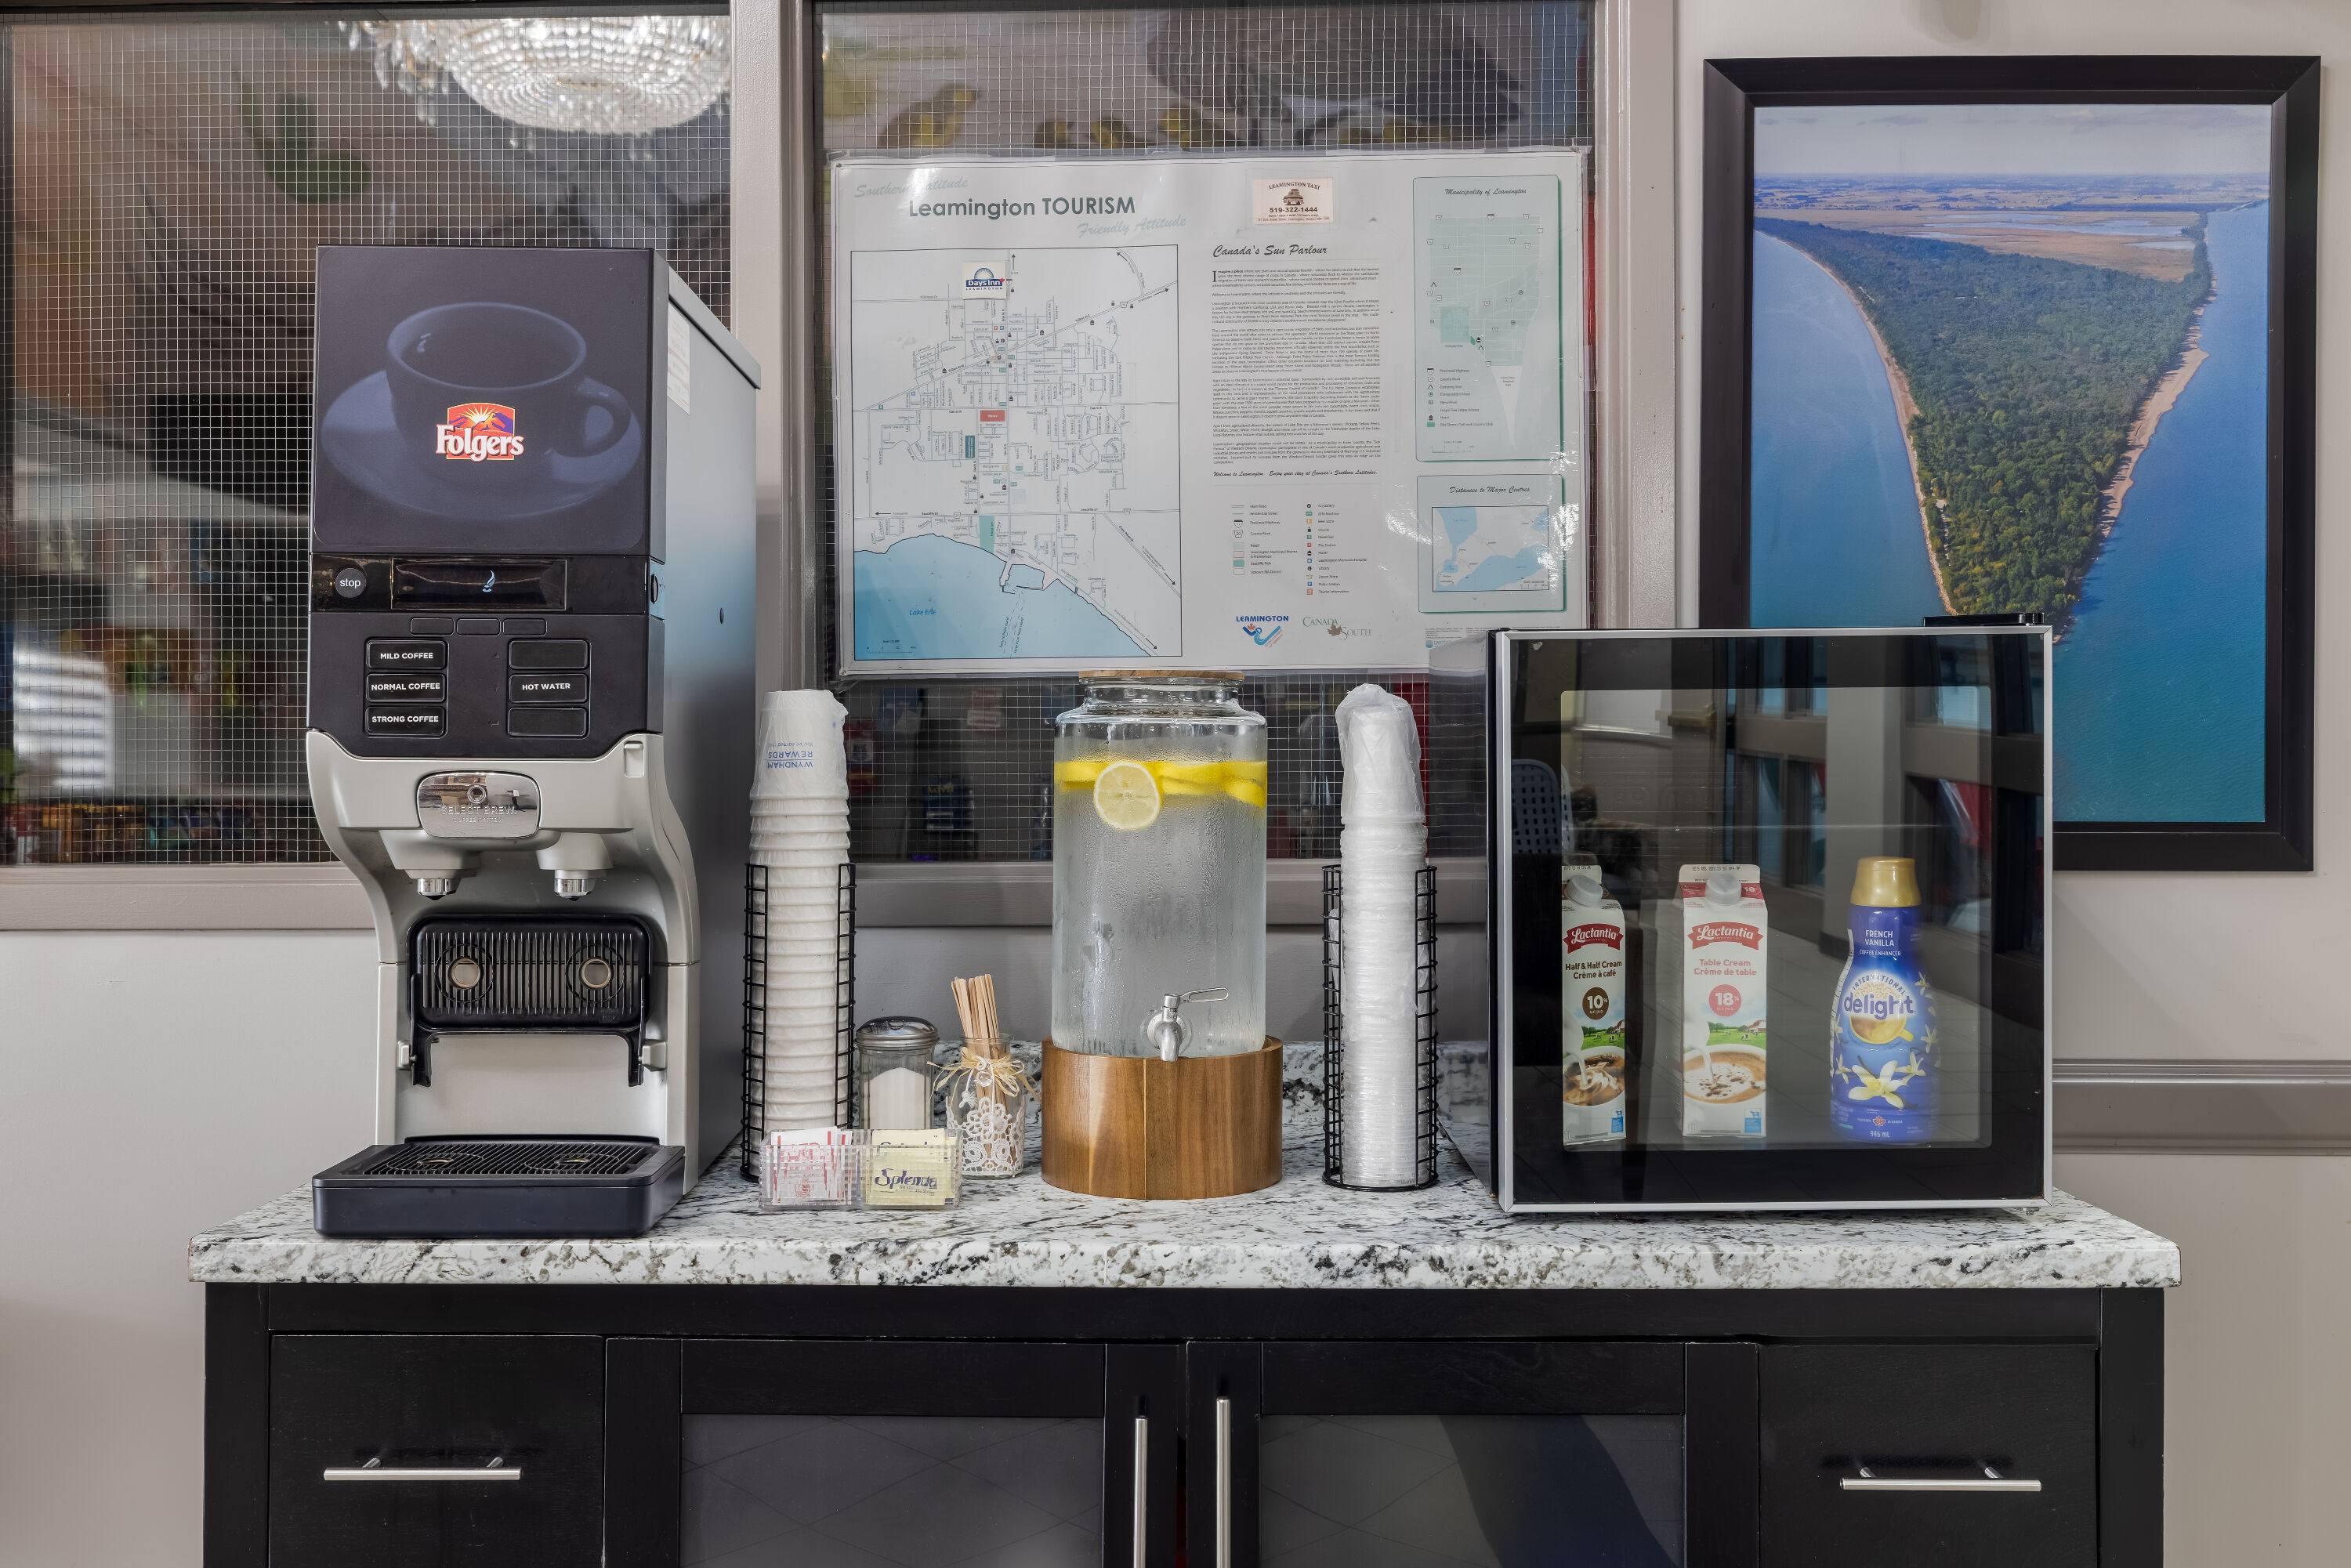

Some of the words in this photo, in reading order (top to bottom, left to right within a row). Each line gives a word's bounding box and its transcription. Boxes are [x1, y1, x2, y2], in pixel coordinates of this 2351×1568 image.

[855, 182, 910, 197] Southern
[918, 176, 969, 190] atitude
[1445, 188, 1483, 197] Municipality
[1493, 187, 1527, 196] Leamington
[910, 198, 1035, 220] Leamington
[1042, 197, 1136, 215] TOURISM
[1077, 221, 1128, 238] Friendly
[1134, 215, 1186, 231] Attitude
[1213, 244, 1260, 257] Canada's
[1264, 244, 1285, 255] Sun
[1289, 244, 1328, 255] Parlour
[436, 424, 524, 462] Folgers
[1509, 485, 1531, 494] Centres
[339, 577, 361, 589] stop
[440, 806, 480, 815] SELECT
[1570, 925, 1617, 943] Lactantia
[1697, 925, 1755, 941] Lactantia
[1865, 929, 1893, 938] FRENCH
[1587, 961, 1601, 970] Half
[1722, 958, 1751, 967] Cream
[1694, 967, 1722, 976] Crème
[1852, 974, 1906, 996] INTERNATIONAL
[1843, 992, 1914, 1020] delight
[874, 1168, 938, 1190] Splenda
